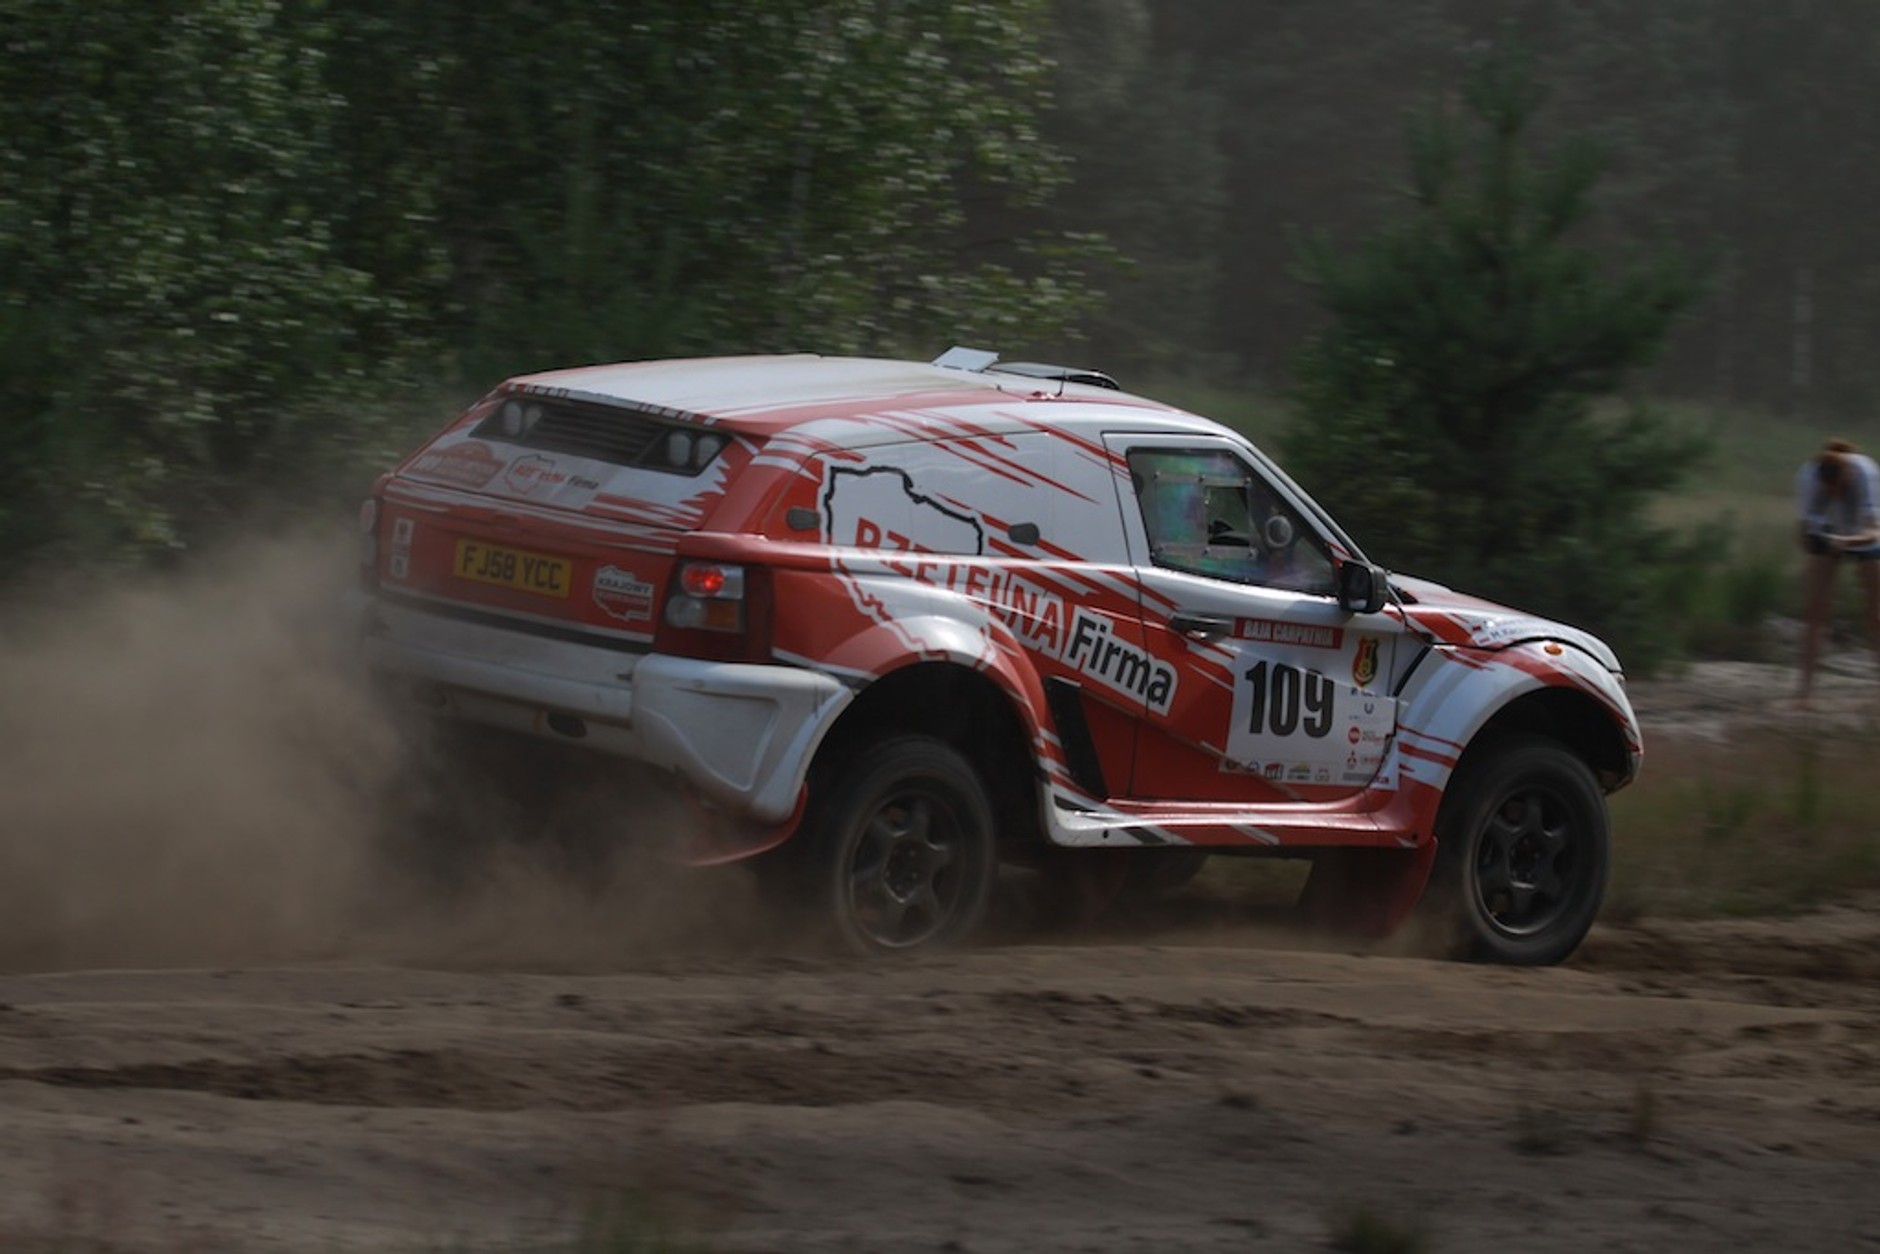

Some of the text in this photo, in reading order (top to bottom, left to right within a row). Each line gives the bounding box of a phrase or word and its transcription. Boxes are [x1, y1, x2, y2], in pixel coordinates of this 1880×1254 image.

[462, 545, 562, 590] FJ58 YCC
[1068, 614, 1173, 706] Firma
[1245, 660, 1335, 739] 109
